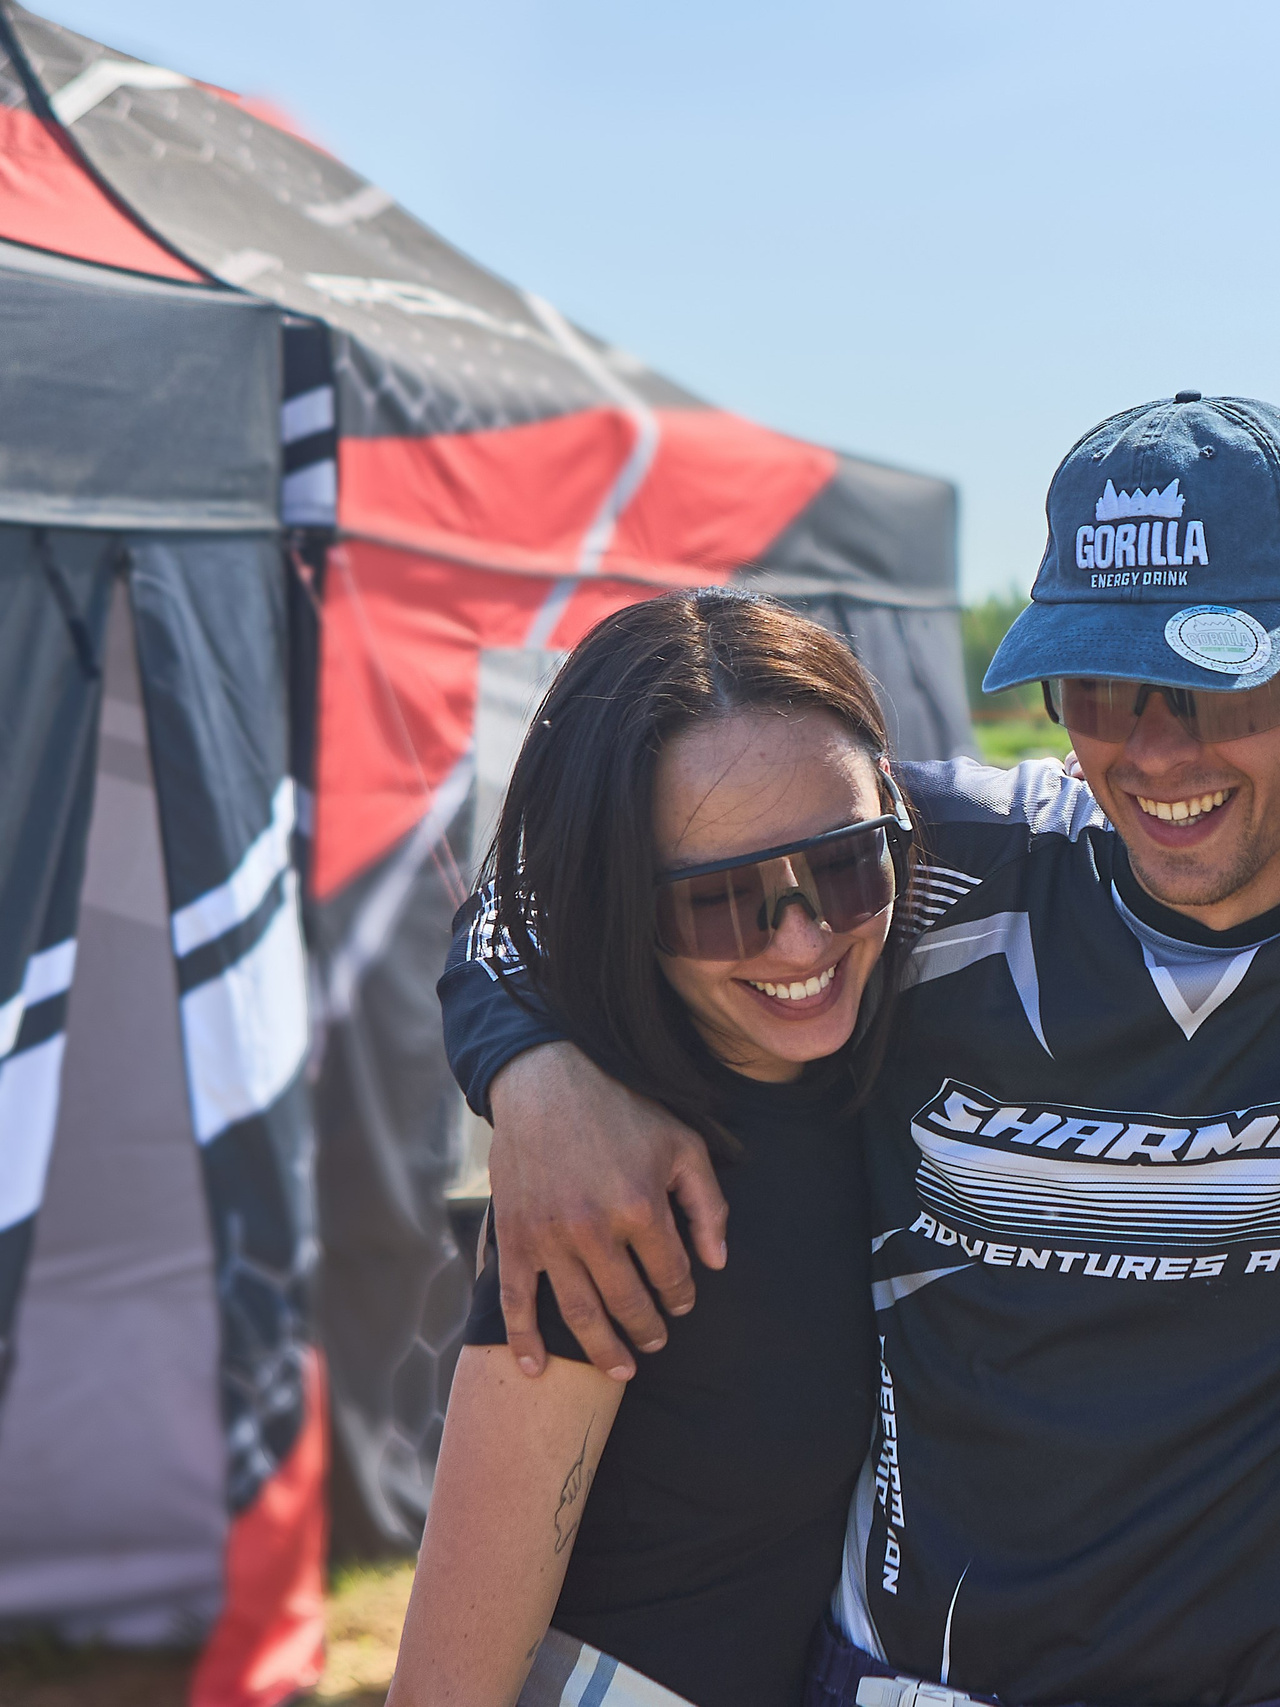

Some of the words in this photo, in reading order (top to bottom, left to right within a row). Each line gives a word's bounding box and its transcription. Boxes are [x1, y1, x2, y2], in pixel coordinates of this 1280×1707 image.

[1076, 520, 1209, 569] GORILLA
[1091, 572, 1140, 588] ENERGY
[1143, 570, 1188, 586] DRINK
[1186, 632, 1254, 647] GORILLA
[908, 1210, 1228, 1281] ADVENTURES
